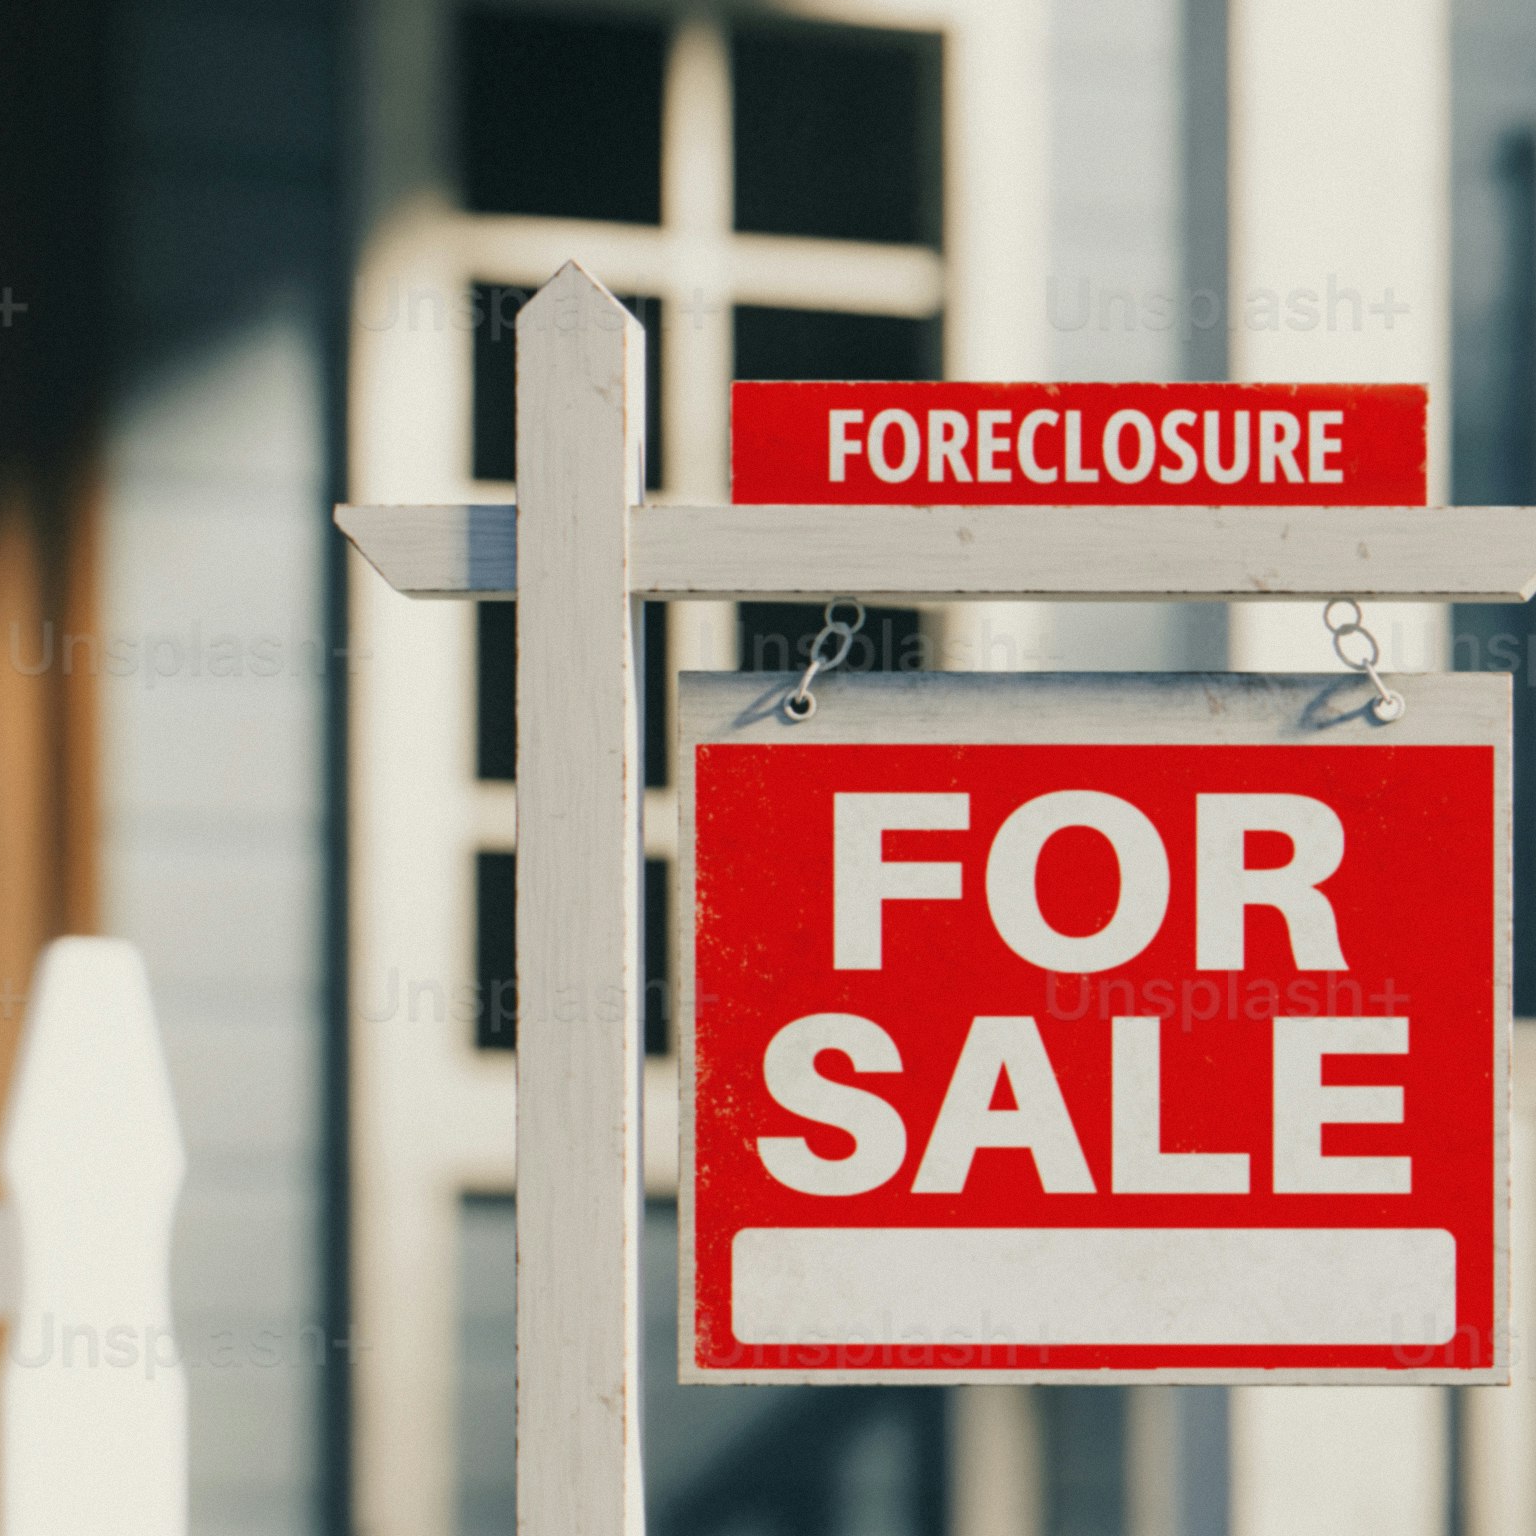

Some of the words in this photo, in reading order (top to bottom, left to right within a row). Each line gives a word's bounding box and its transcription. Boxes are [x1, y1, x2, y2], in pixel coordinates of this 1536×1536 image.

[829, 409, 1344, 484] FORECLOSURE
[834, 790, 1350, 973] FOR
[757, 1013, 1412, 1196] SALE
